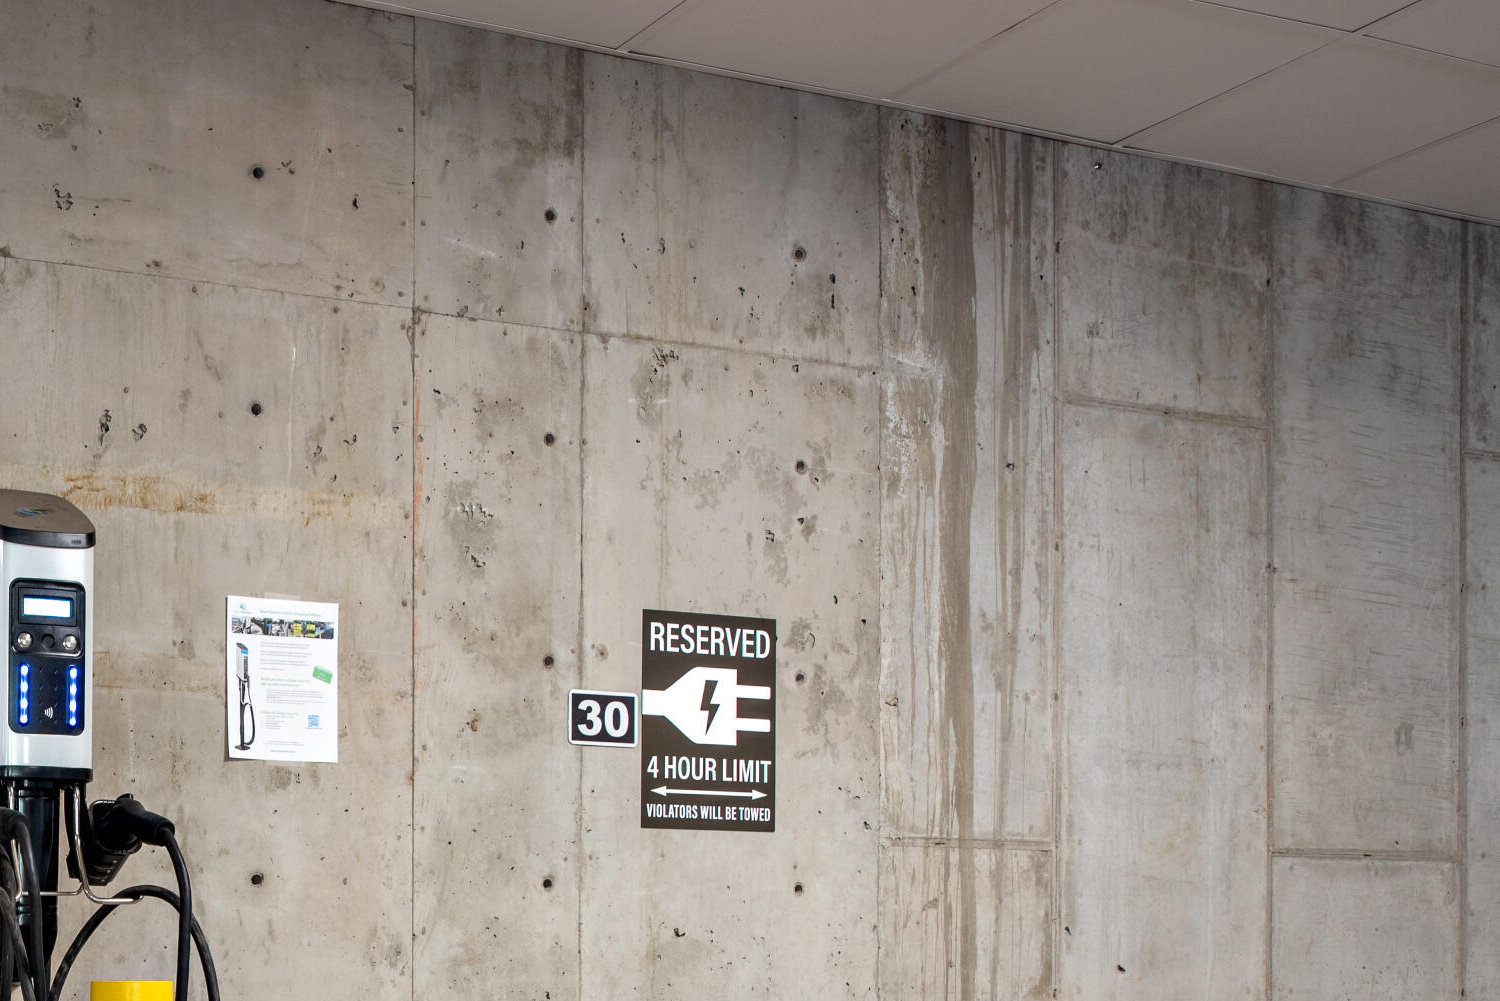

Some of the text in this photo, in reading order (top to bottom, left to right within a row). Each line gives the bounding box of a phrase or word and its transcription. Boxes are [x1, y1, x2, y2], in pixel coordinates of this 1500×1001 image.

[650, 621, 771, 659] RESERVED
[577, 699, 630, 738] 30
[646, 755, 772, 783] 4 HOUR LIMIT
[646, 803, 771, 822] VIOLATORS WILL BE TOWED
